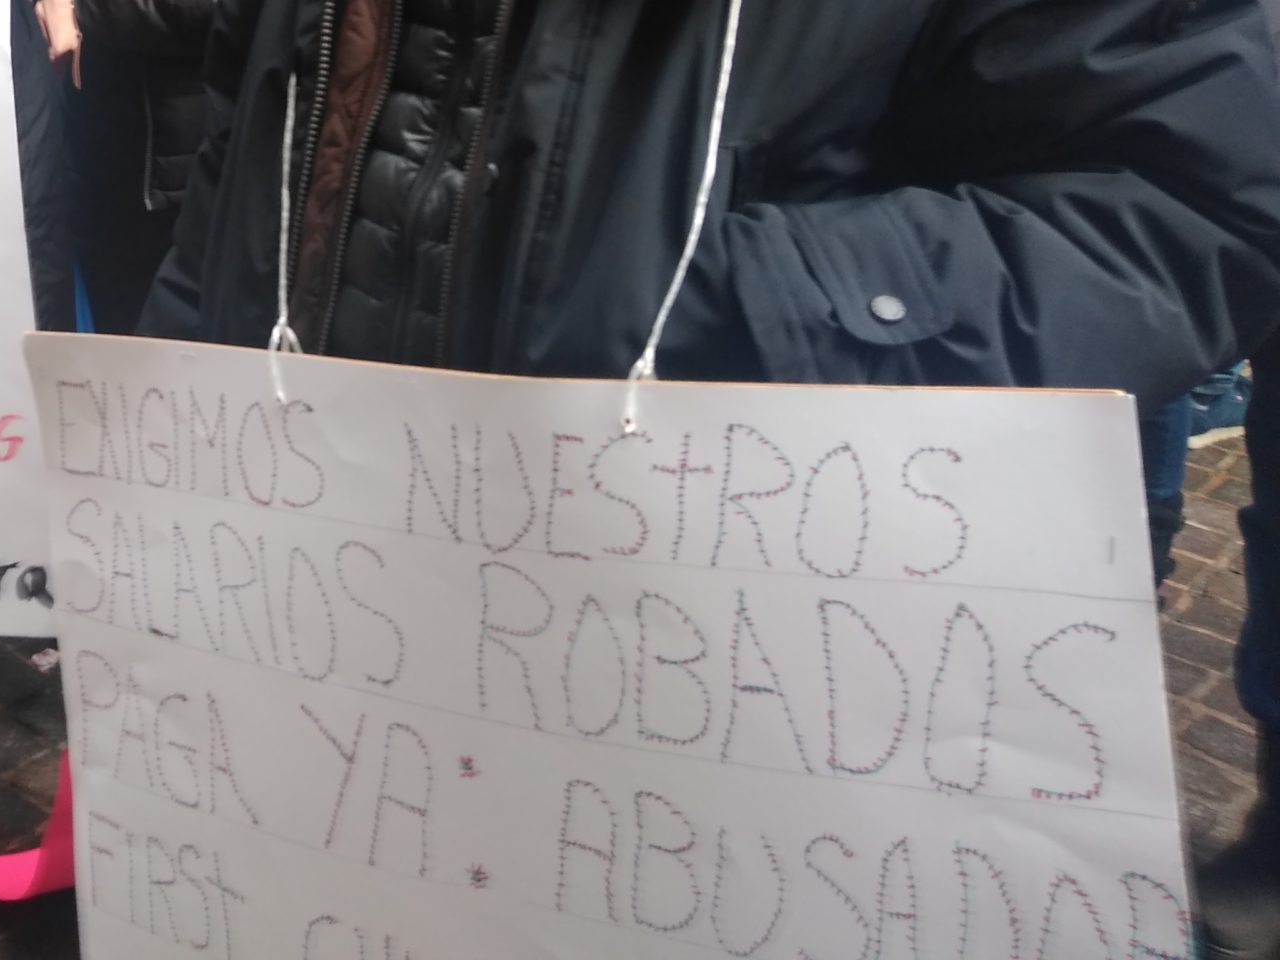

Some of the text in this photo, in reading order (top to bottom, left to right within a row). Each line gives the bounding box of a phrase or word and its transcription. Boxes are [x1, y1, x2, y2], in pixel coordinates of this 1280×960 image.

[54, 379, 325, 510] EXIGIMOS
[64, 496, 1118, 802] SALARIOS ROBADOS
[73, 648, 261, 827] PAGA
